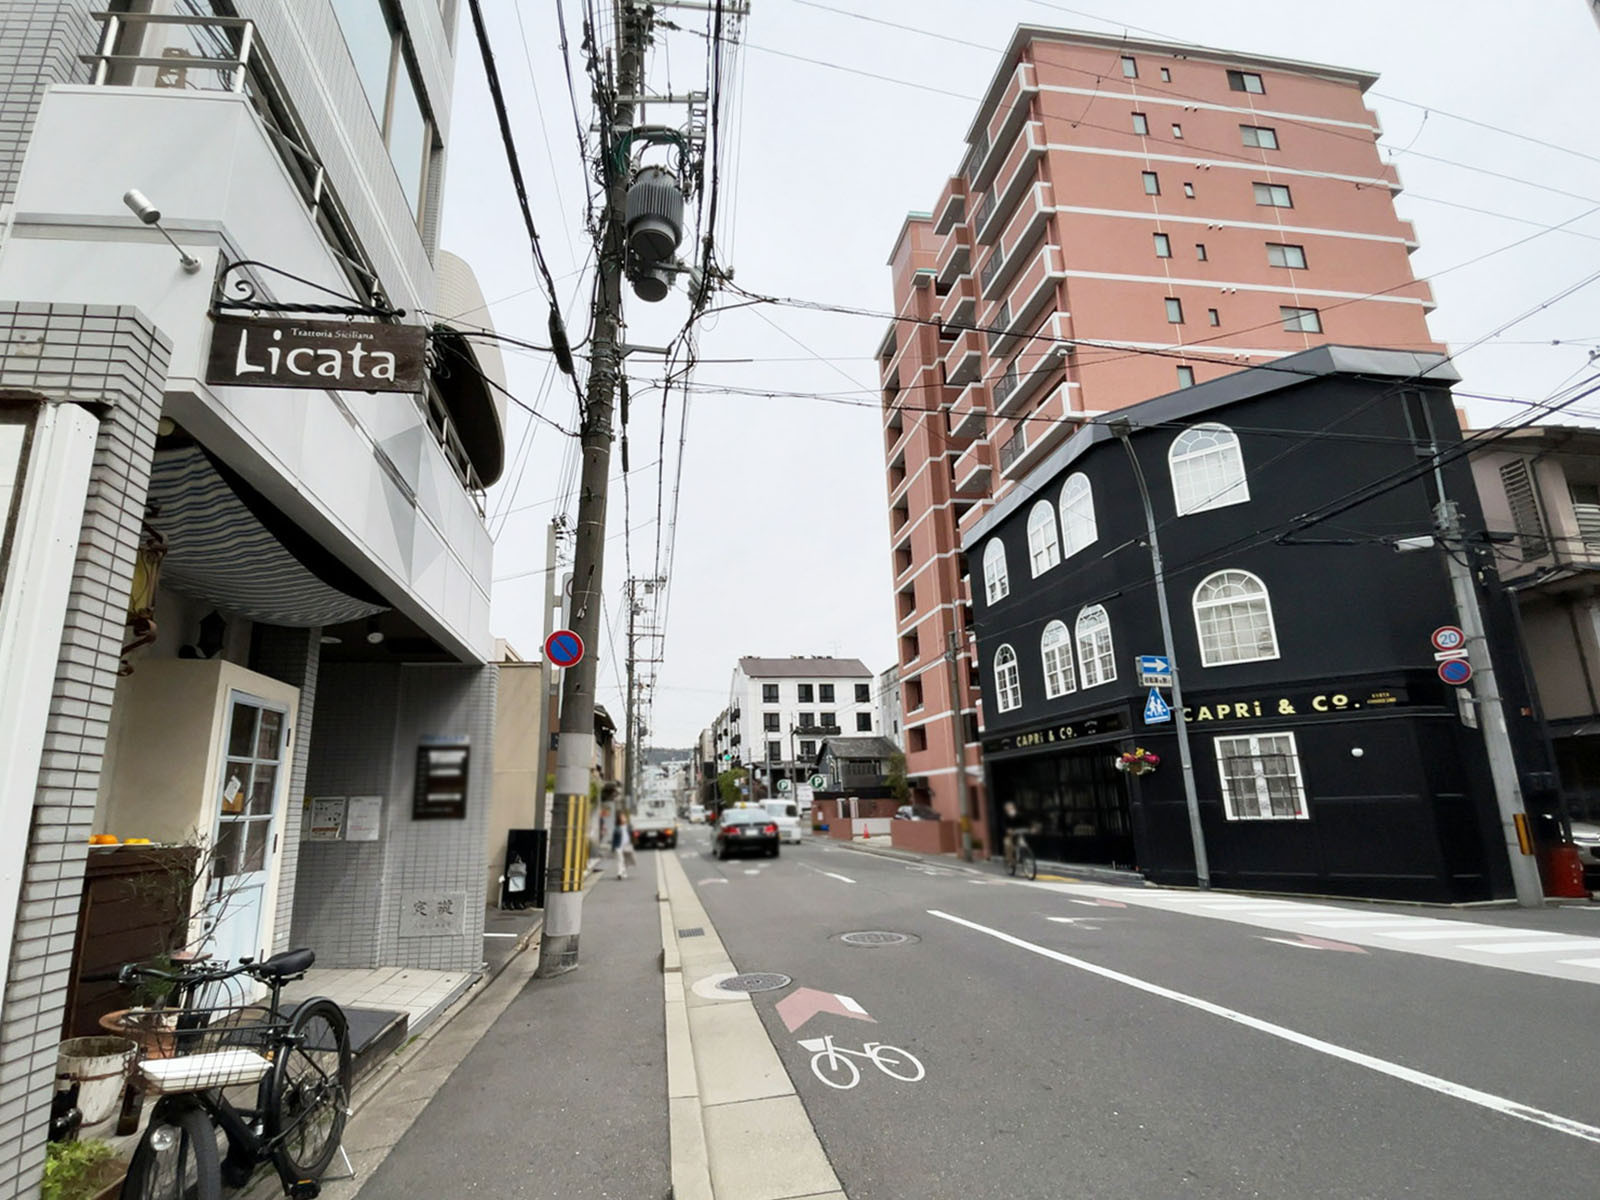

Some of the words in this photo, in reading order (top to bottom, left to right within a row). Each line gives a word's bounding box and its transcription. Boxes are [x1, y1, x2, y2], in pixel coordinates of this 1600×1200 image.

[291, 327, 333, 338] Trattoria
[334, 329, 374, 340] Siciliana
[235, 328, 396, 382] Licata
[1440, 632, 1458, 645] 20
[1278, 698, 1296, 714] &
[1048, 730, 1055, 741] &
